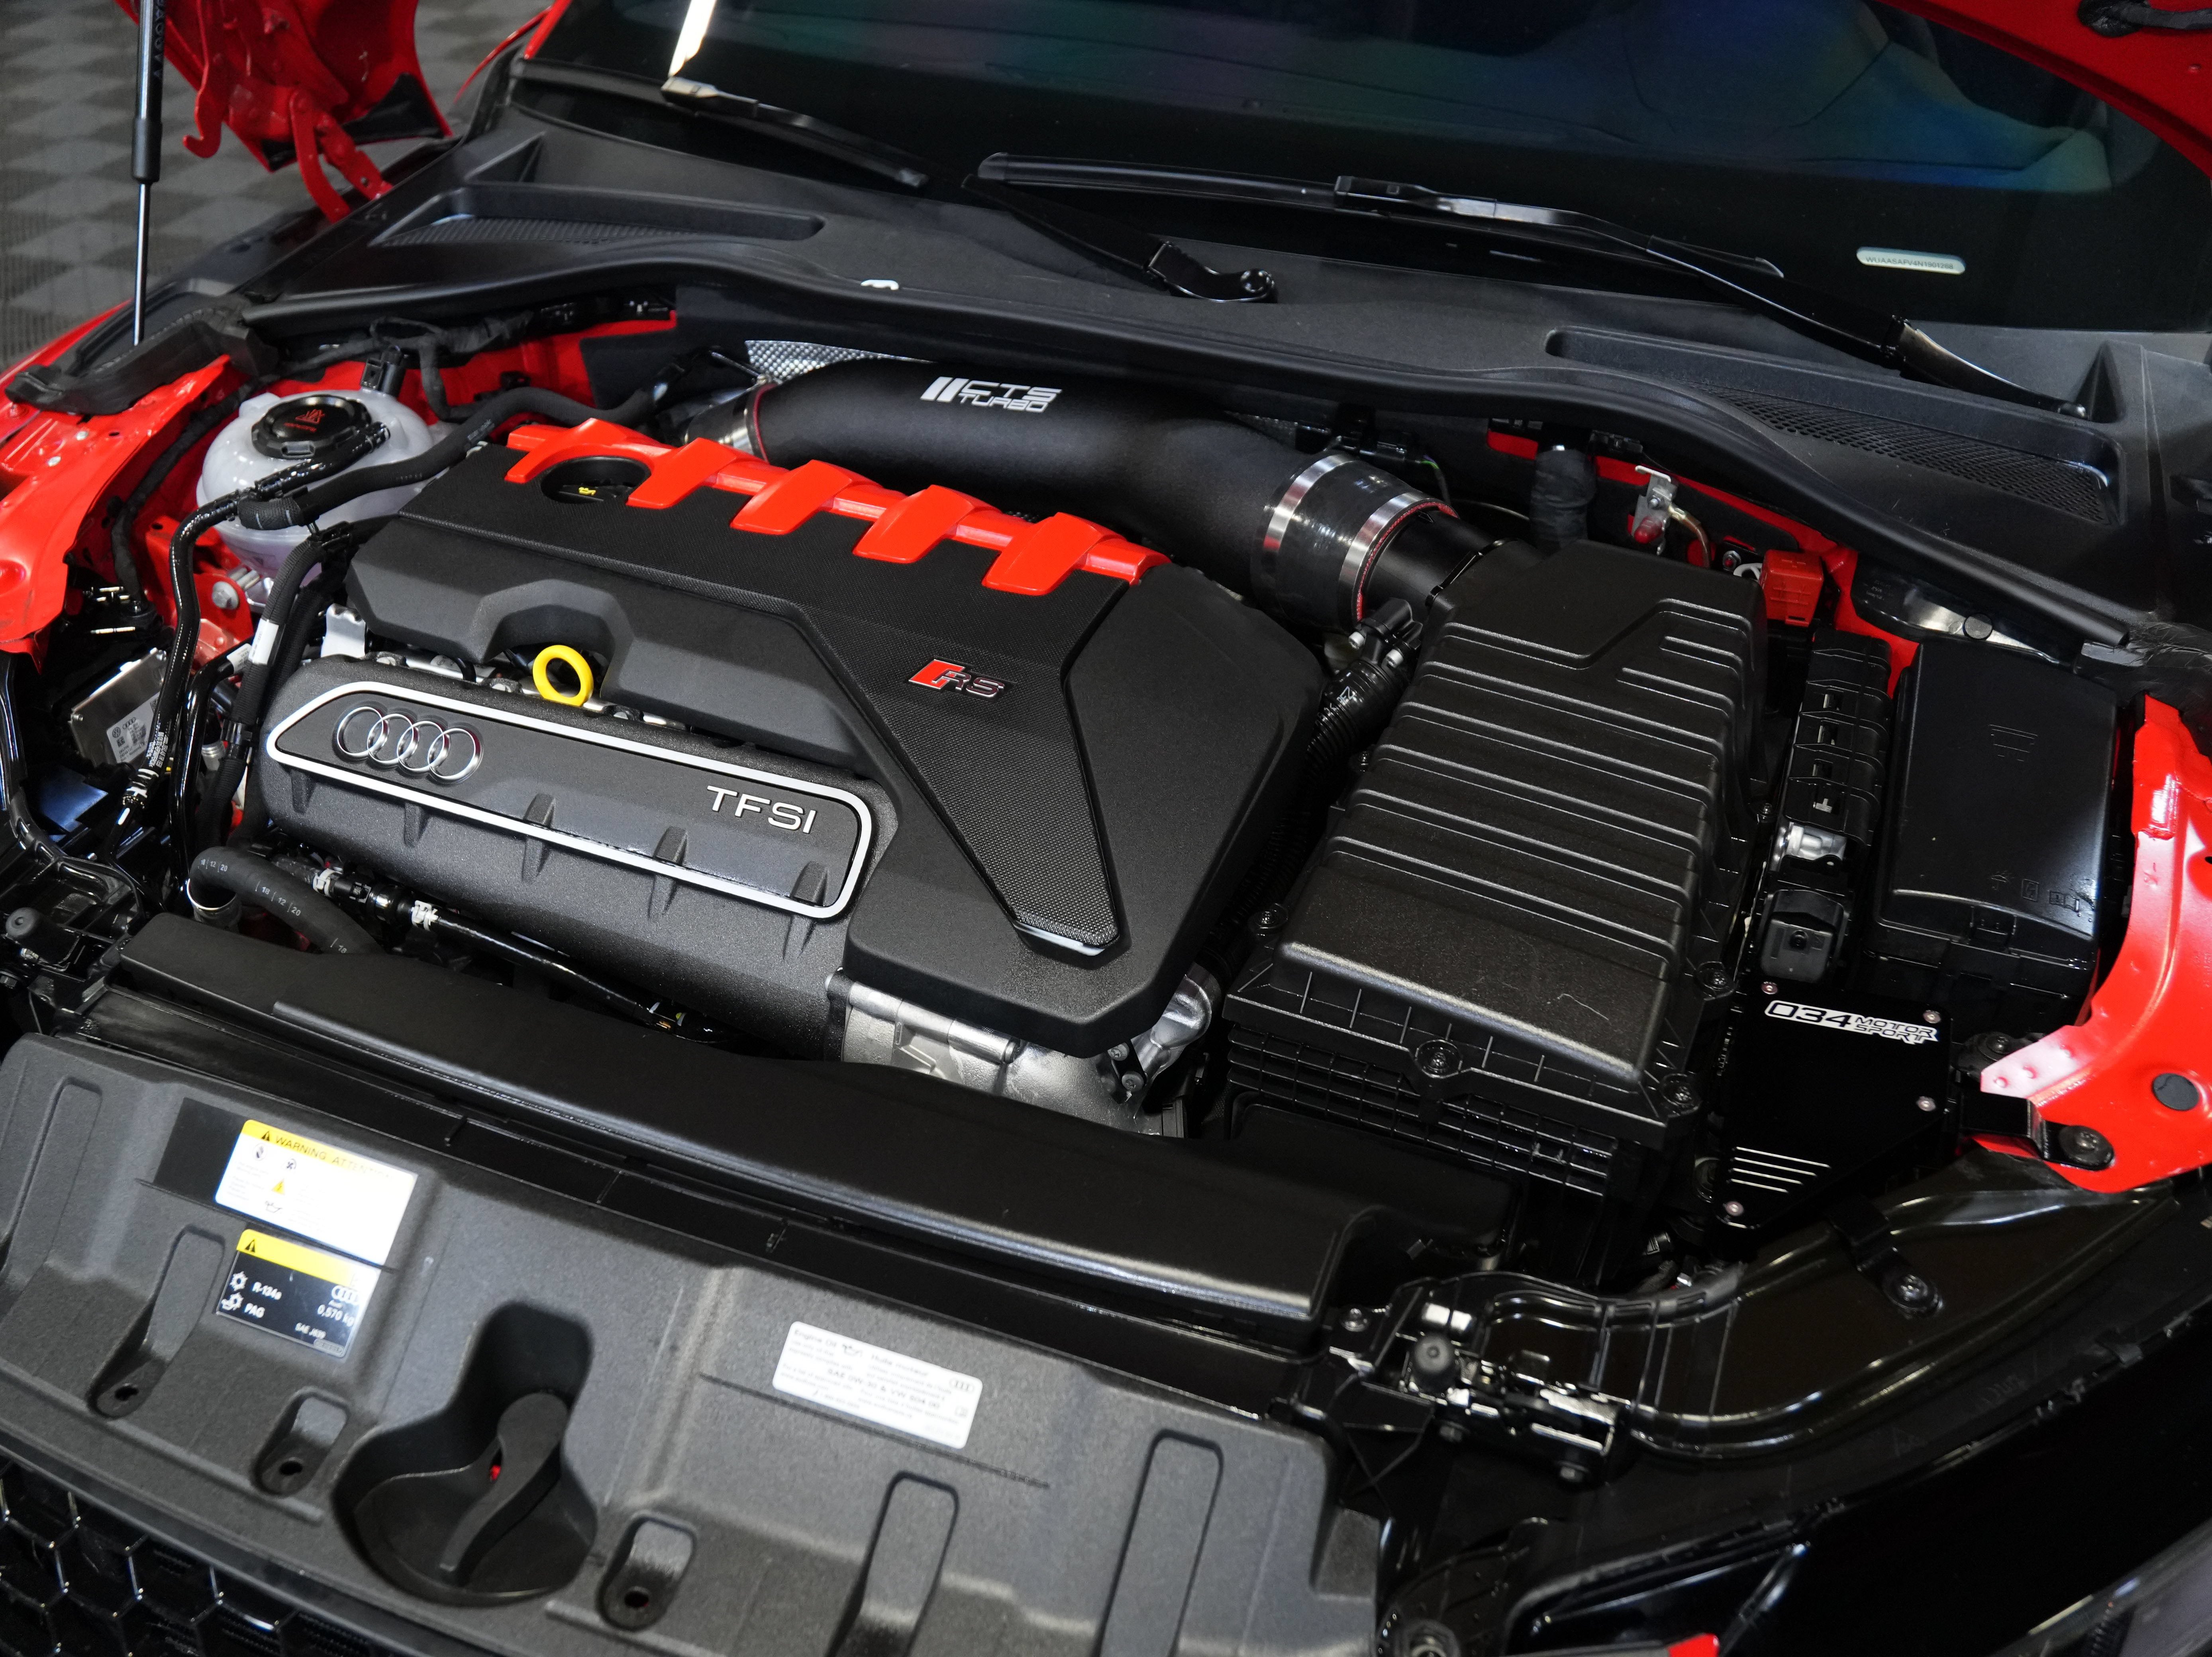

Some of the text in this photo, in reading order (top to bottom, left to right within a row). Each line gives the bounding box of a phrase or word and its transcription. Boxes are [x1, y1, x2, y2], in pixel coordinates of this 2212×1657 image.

[961, 380, 1062, 402] CTS
[958, 393, 1049, 413] TURBO
[931, 670, 1005, 698] RS
[707, 785, 818, 833] TFSI
[278, 897, 286, 906] 12
[291, 907, 302, 917] 20
[1769, 1002, 1851, 1027] 034
[1854, 1024, 1928, 1041] SPORT
[1855, 1017, 1933, 1037] MOTOR
[275, 1136, 327, 1160] WARNING
[244, 1303, 265, 1318] PAG
